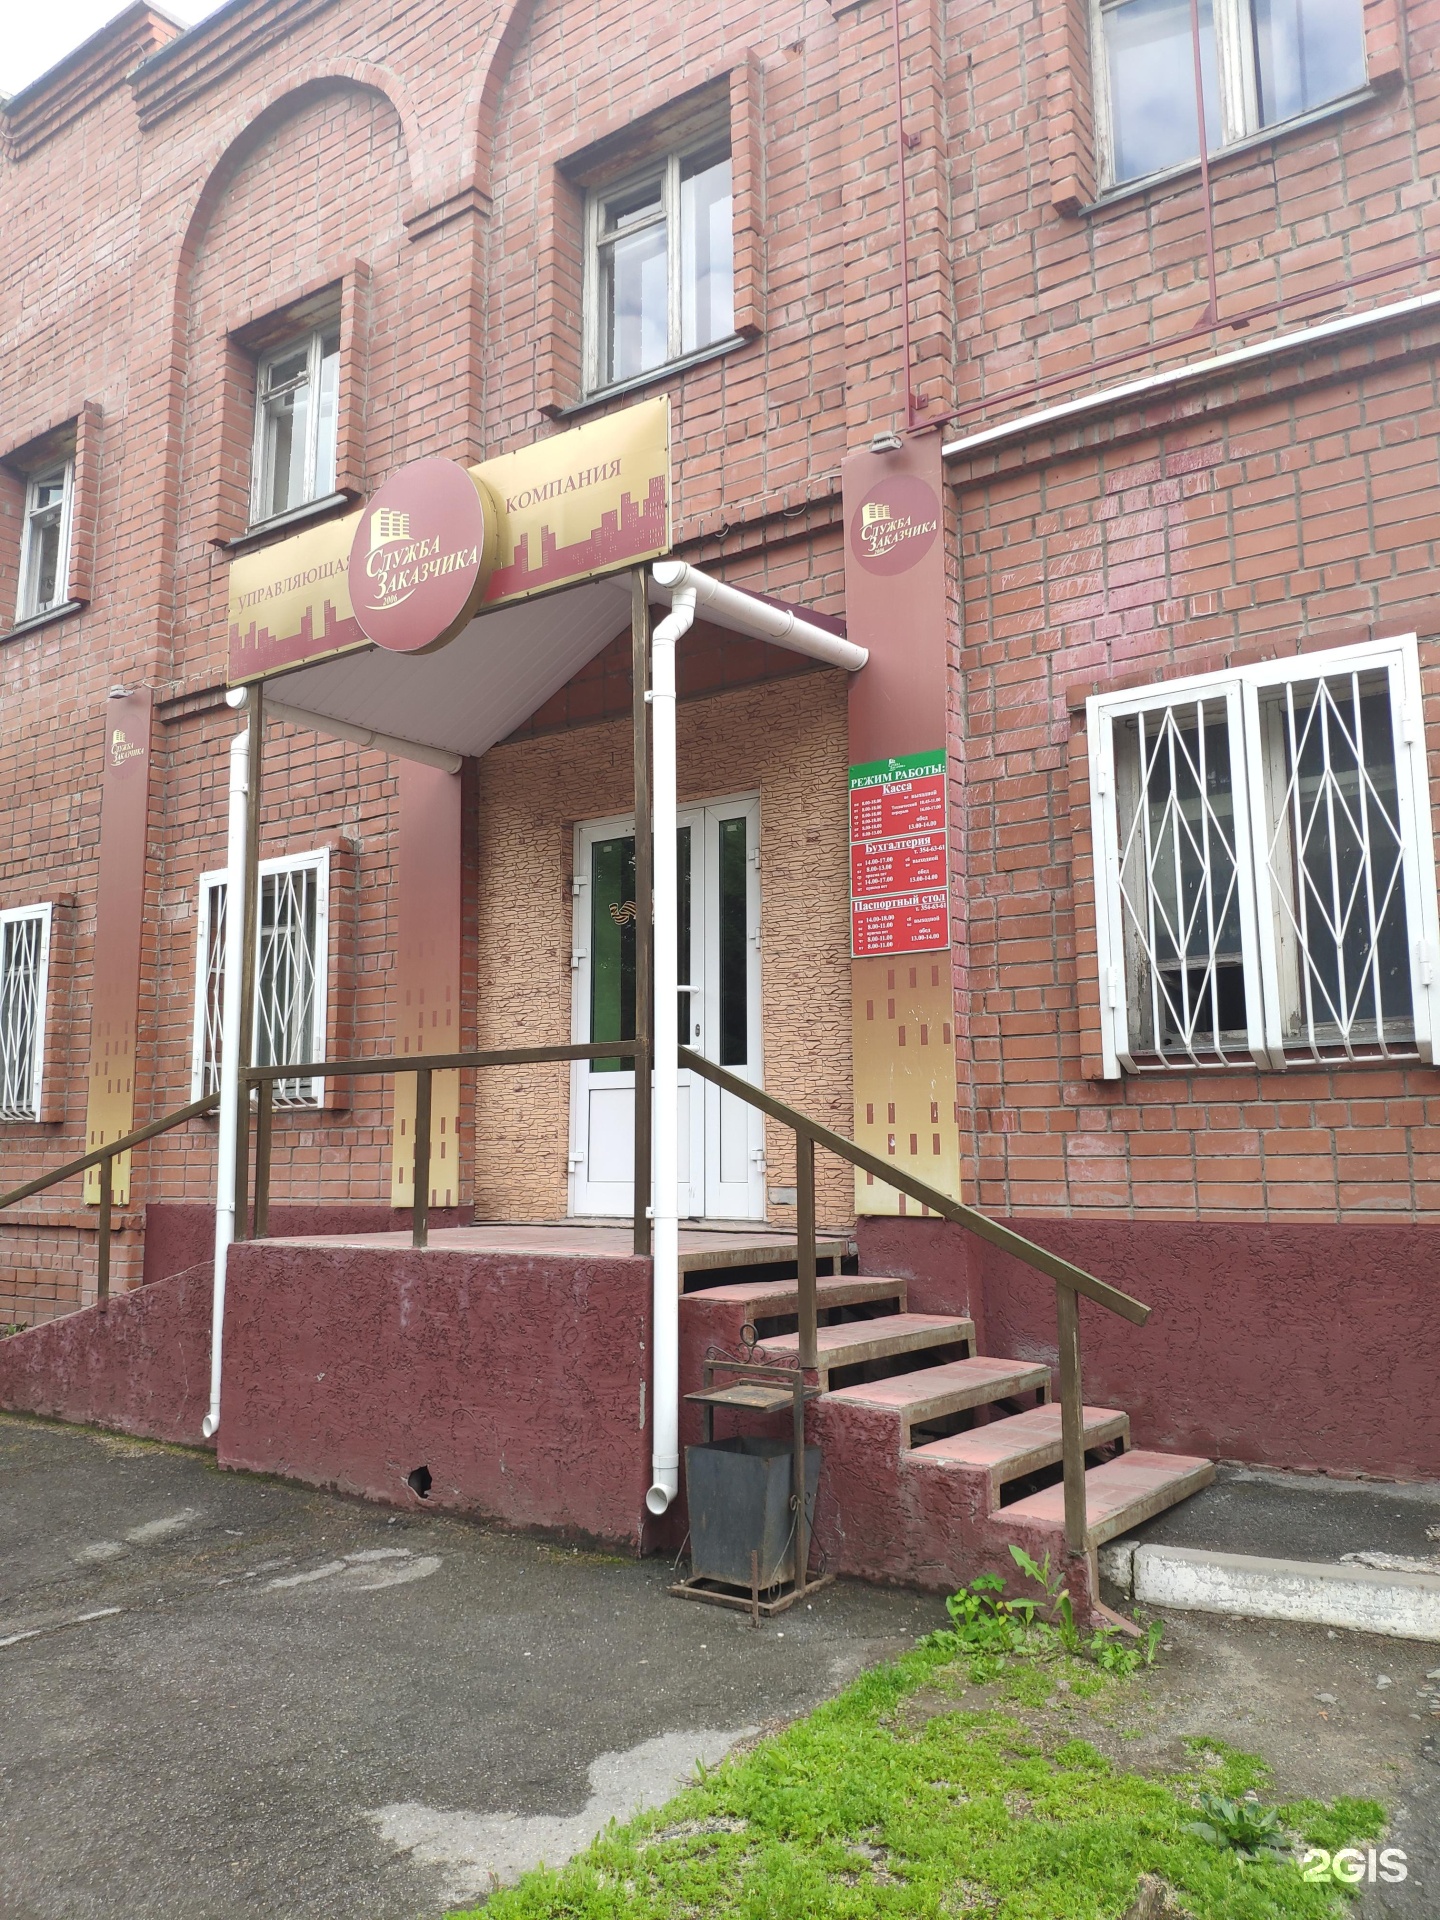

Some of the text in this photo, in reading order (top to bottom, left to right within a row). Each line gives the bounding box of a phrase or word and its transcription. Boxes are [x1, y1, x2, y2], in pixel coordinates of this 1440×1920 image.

[505, 458, 622, 514] КОМПАНИЯ
[861, 516, 911, 540] СЛУЖБА
[868, 520, 937, 551] ЗАКАЗЧИКА
[366, 535, 440, 577] СЛУЖБА
[374, 545, 477, 599] ЗАКАЗЧИКА
[851, 773, 892, 788] РЕЖИМ
[895, 764, 946, 780] РАБОТЫ:
[883, 782, 912, 795] Касса
[908, 821, 937, 830] 13.00-14.00
[865, 837, 931, 854] Бухгалтерия
[919, 845, 945, 854] 354-63-61
[865, 856, 893, 865] 14.00-17.00
[865, 876, 893, 885] 14.00-17.00
[854, 894, 945, 911] Паспортный стол
[911, 933, 939, 941] 13.00-14.00
